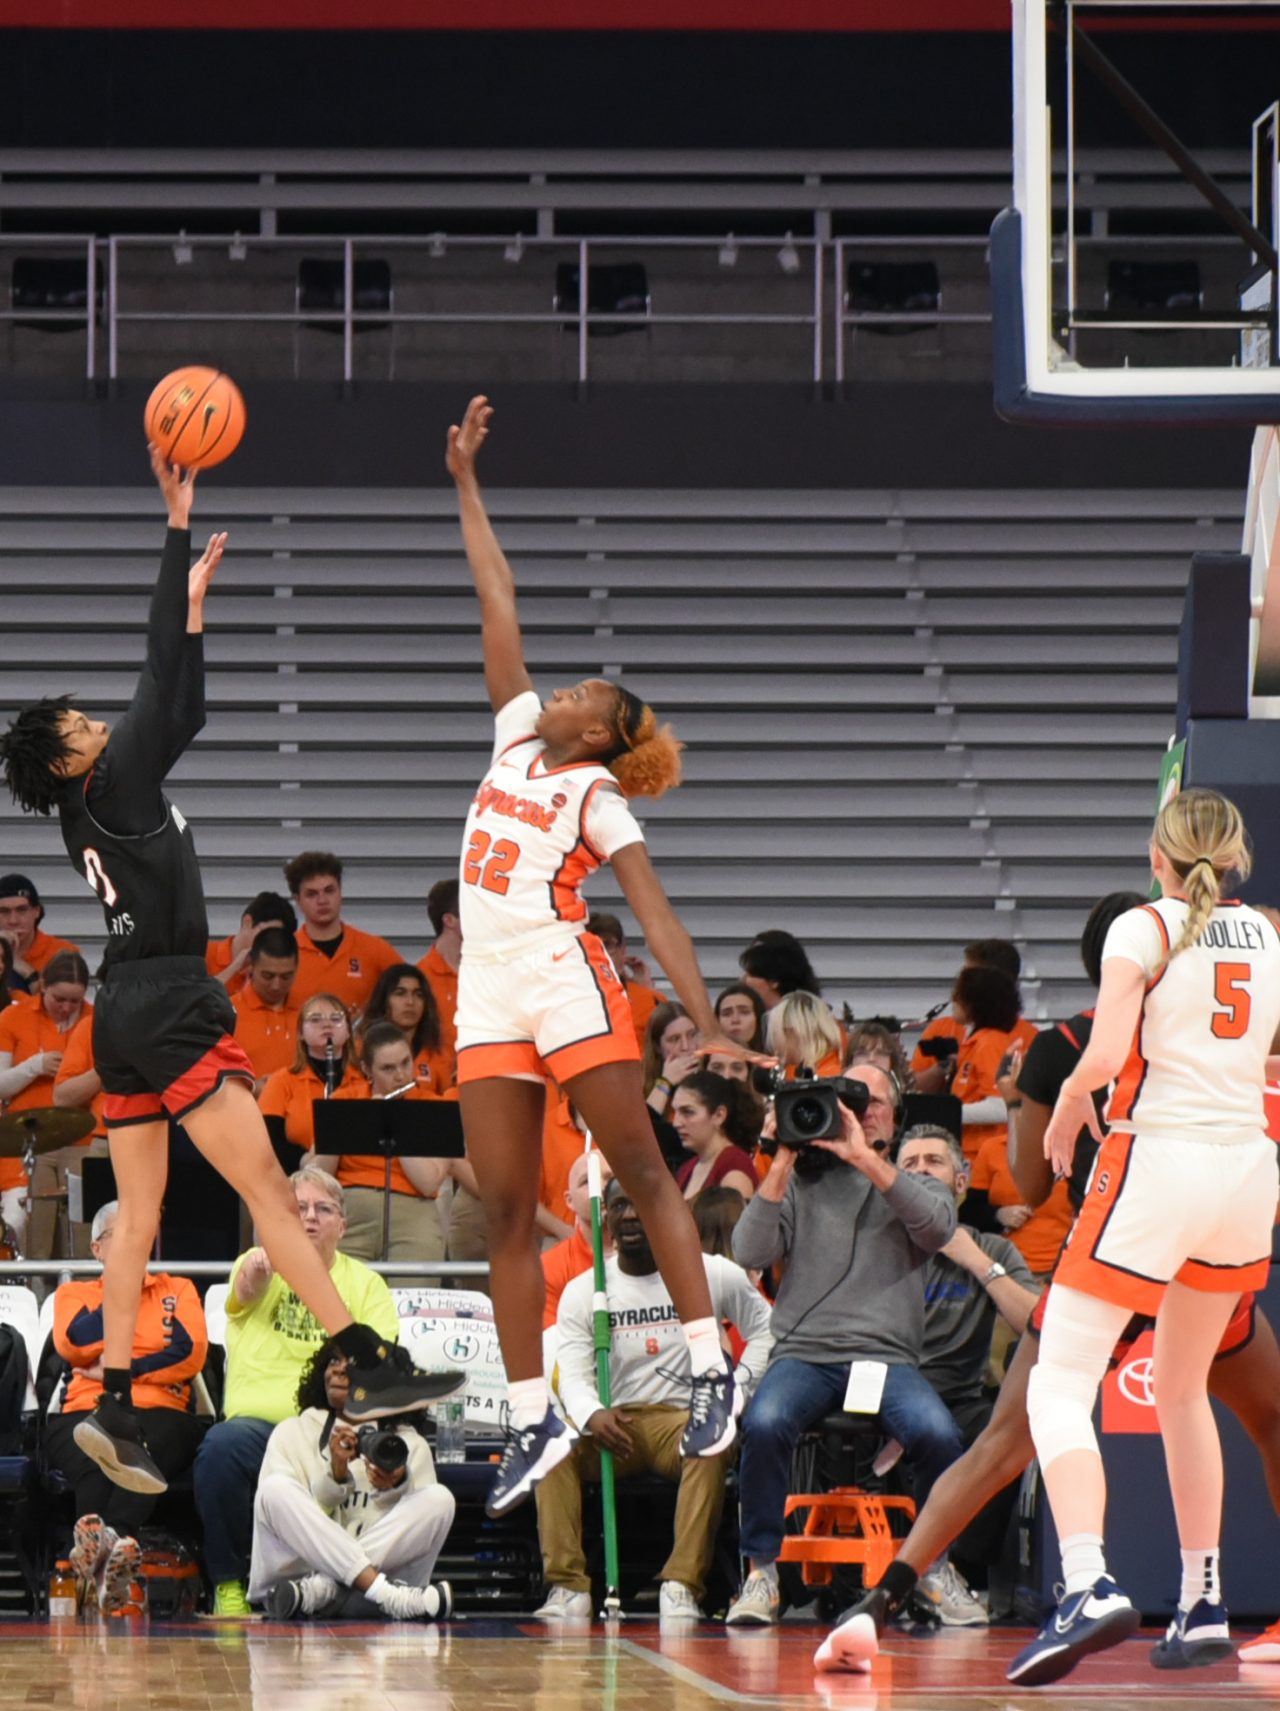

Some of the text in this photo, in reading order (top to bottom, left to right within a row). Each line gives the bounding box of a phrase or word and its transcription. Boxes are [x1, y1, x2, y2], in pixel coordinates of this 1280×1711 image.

[463, 828, 521, 896] 22
[1210, 961, 1252, 1040] 5
[1097, 1173, 1110, 1194] S
[438, 1299, 491, 1314] Hidden
[608, 1304, 680, 1329] SYRACUS
[484, 1398, 494, 1409] A
